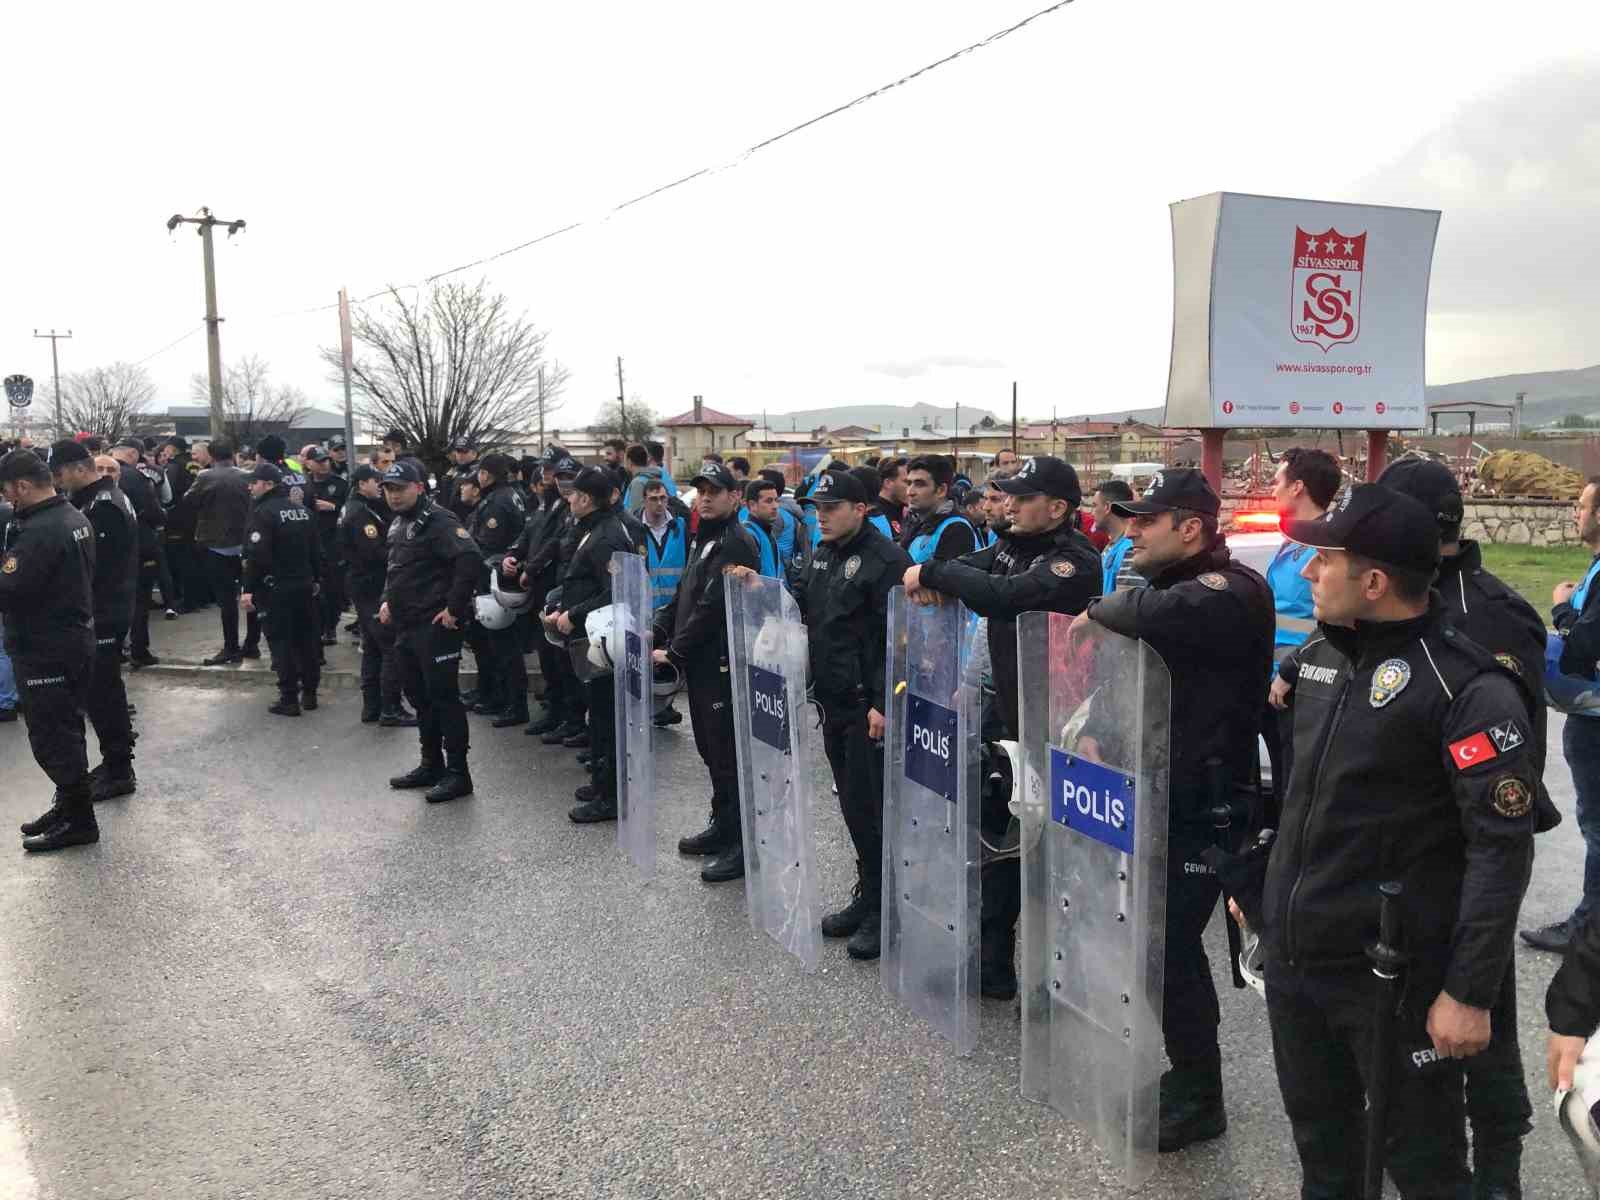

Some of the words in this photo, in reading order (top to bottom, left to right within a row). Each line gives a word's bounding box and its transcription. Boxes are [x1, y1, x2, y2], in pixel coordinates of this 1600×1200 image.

[1297, 254, 1360, 271] SİVASSPOR
[1296, 324, 1315, 335] 1967
[1275, 360, 1373, 376] www.sivasspor.org.tr
[913, 724, 950, 760] POLİS
[1063, 779, 1125, 829] POLİS
